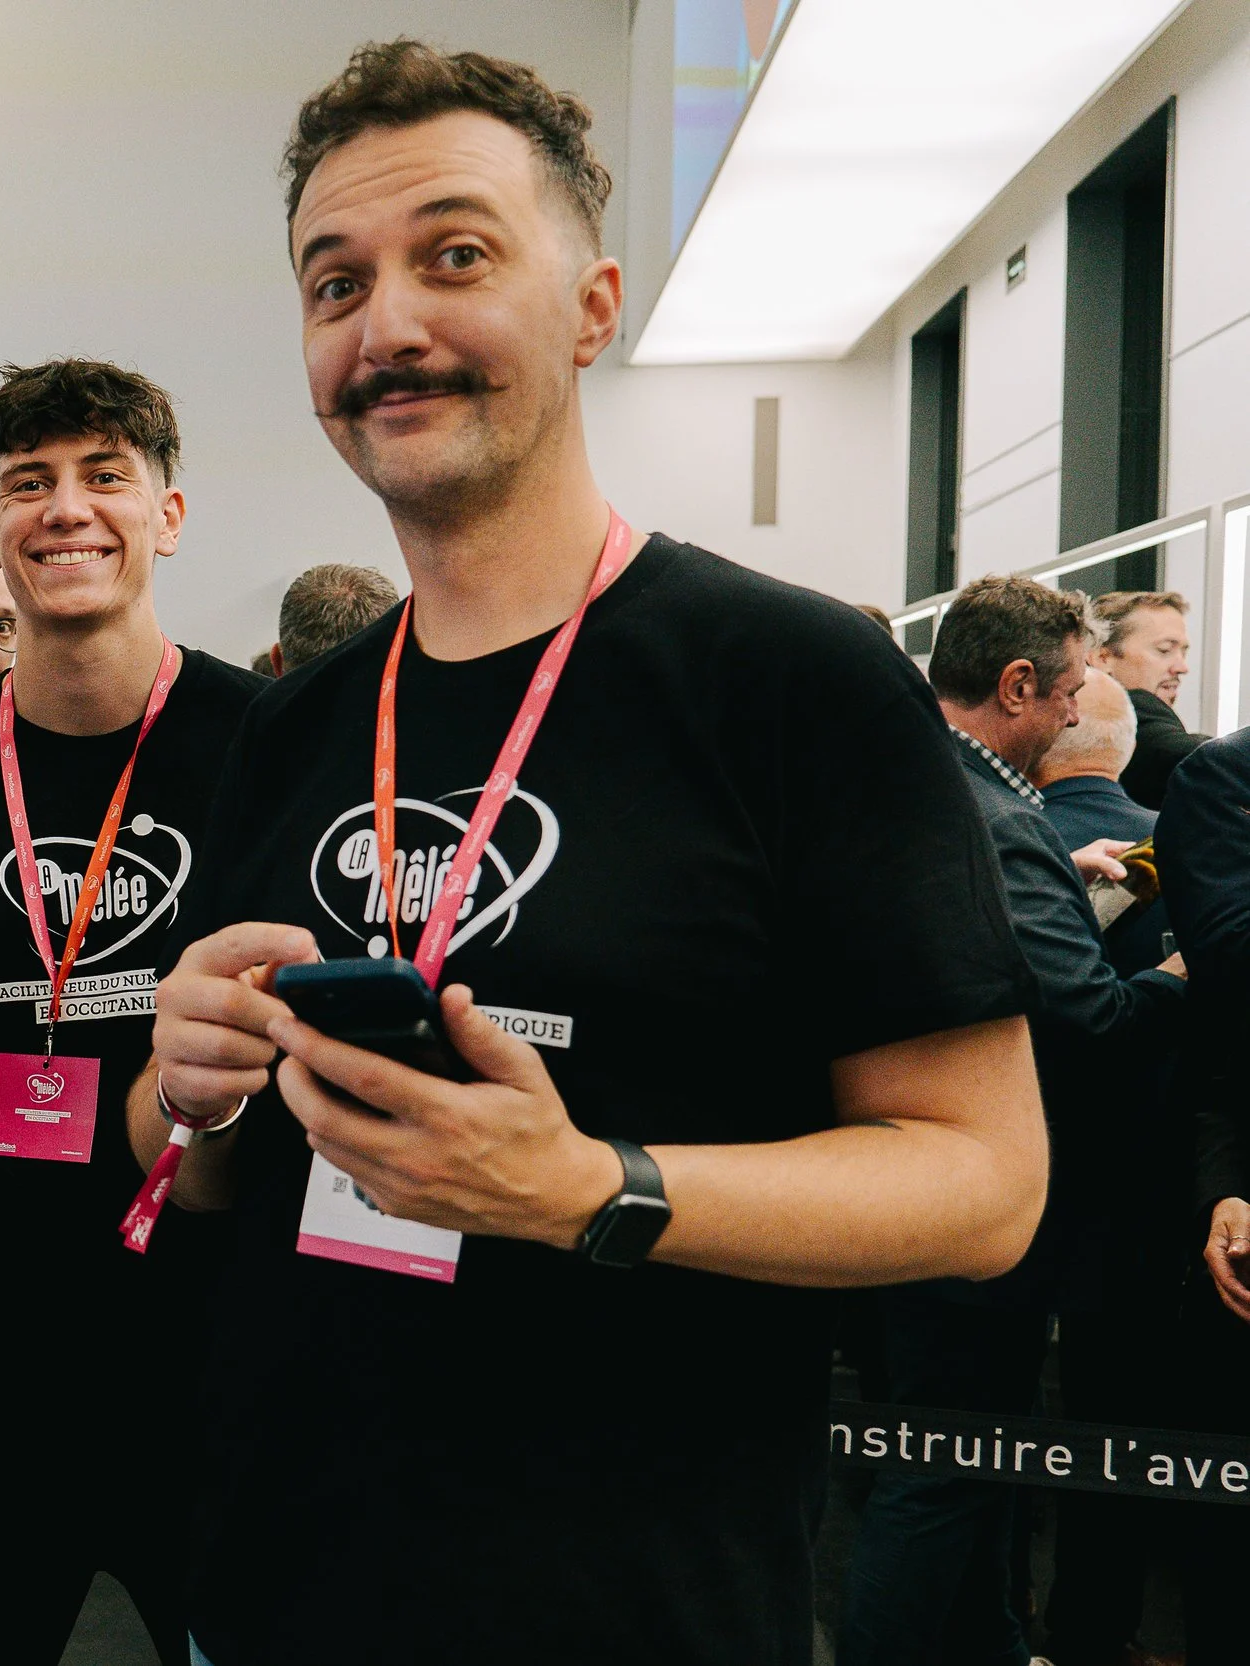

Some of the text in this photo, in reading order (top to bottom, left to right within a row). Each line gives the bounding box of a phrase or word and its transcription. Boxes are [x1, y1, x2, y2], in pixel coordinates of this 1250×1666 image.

[348, 838, 370, 870] LA
[100, 977, 120, 990] DU
[66, 996, 157, 1017] OCCITANI
[830, 1422, 1250, 1493] nstruire l'ave
